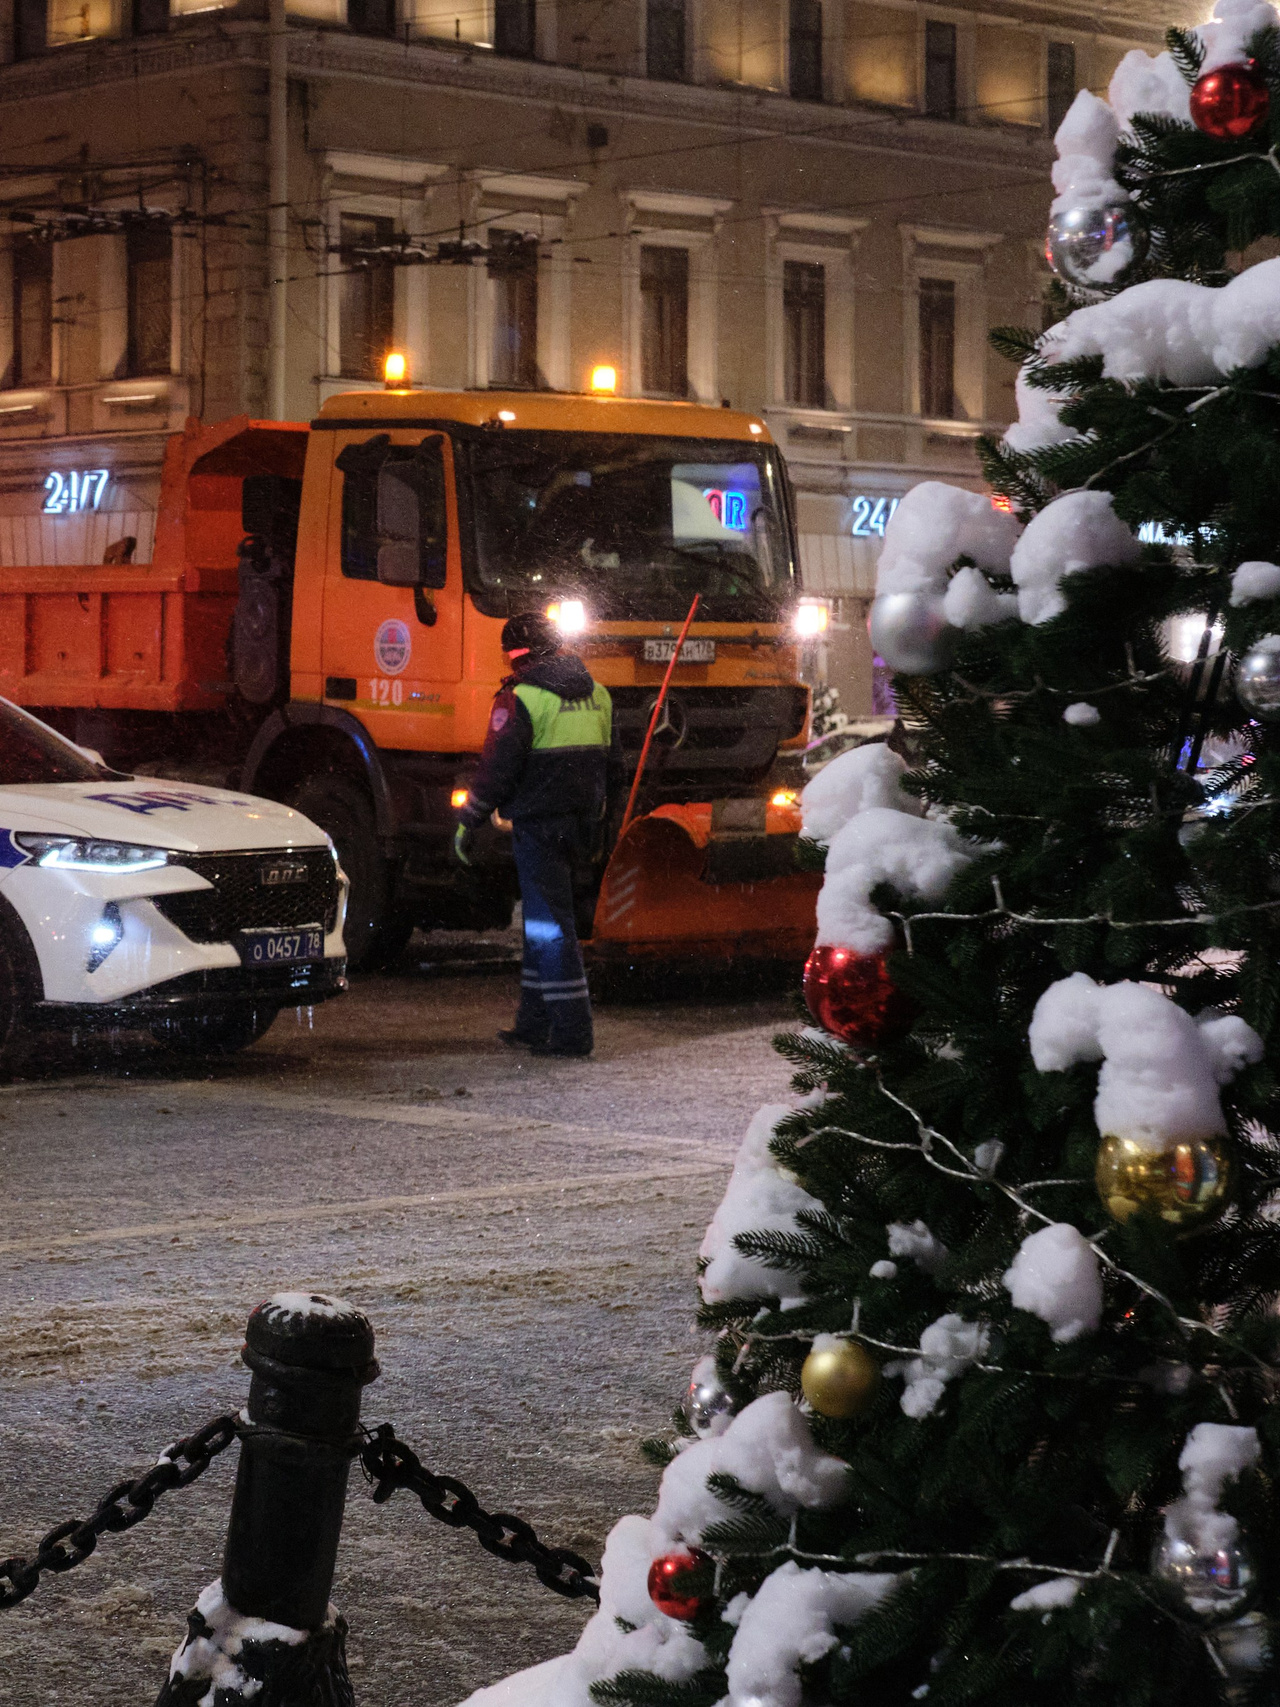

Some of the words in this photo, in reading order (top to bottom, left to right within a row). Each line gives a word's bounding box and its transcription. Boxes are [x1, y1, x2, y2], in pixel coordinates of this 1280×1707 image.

[43, 469, 109, 514] 24/7
[369, 677, 403, 706] 120
[267, 935, 301, 959] 0457
[307, 932, 321, 949] 78
